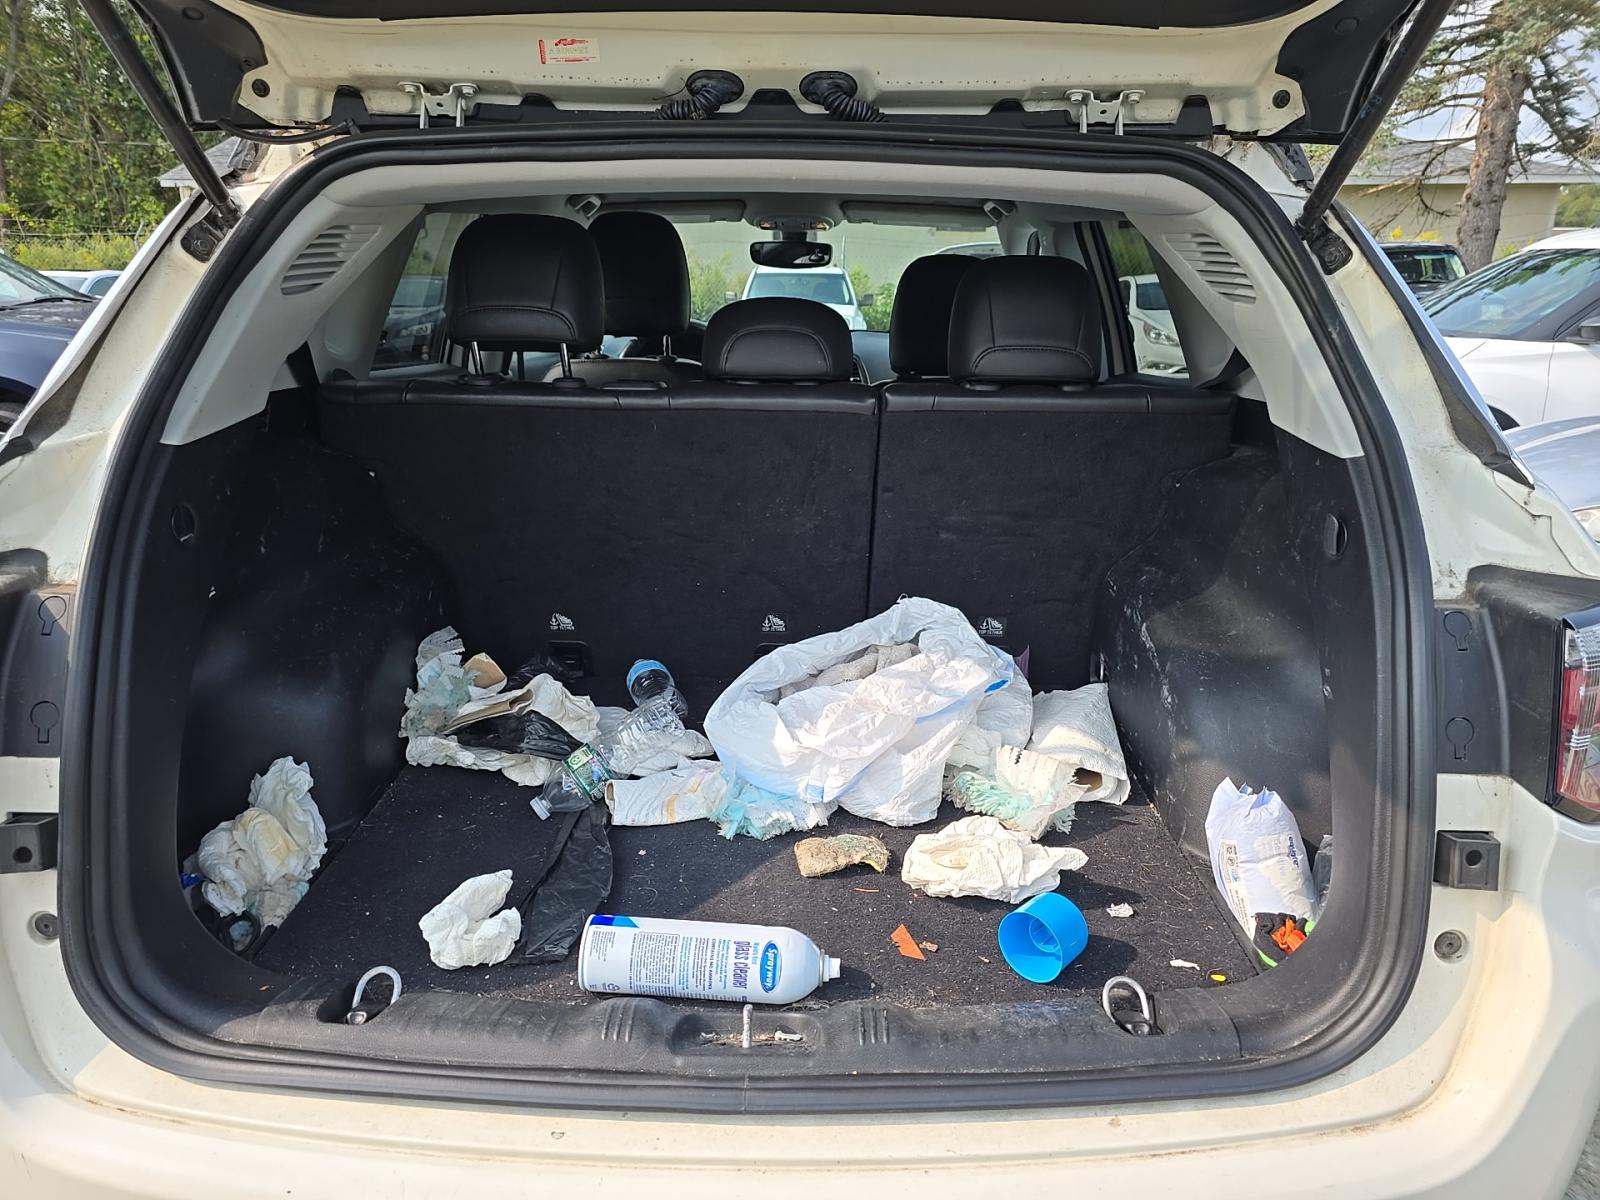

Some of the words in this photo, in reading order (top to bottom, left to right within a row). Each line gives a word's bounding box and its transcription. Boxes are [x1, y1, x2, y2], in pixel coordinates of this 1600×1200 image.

[733, 940, 752, 960] glass
[732, 962, 751, 989] cleaner
[764, 947, 778, 988] Sprayway
